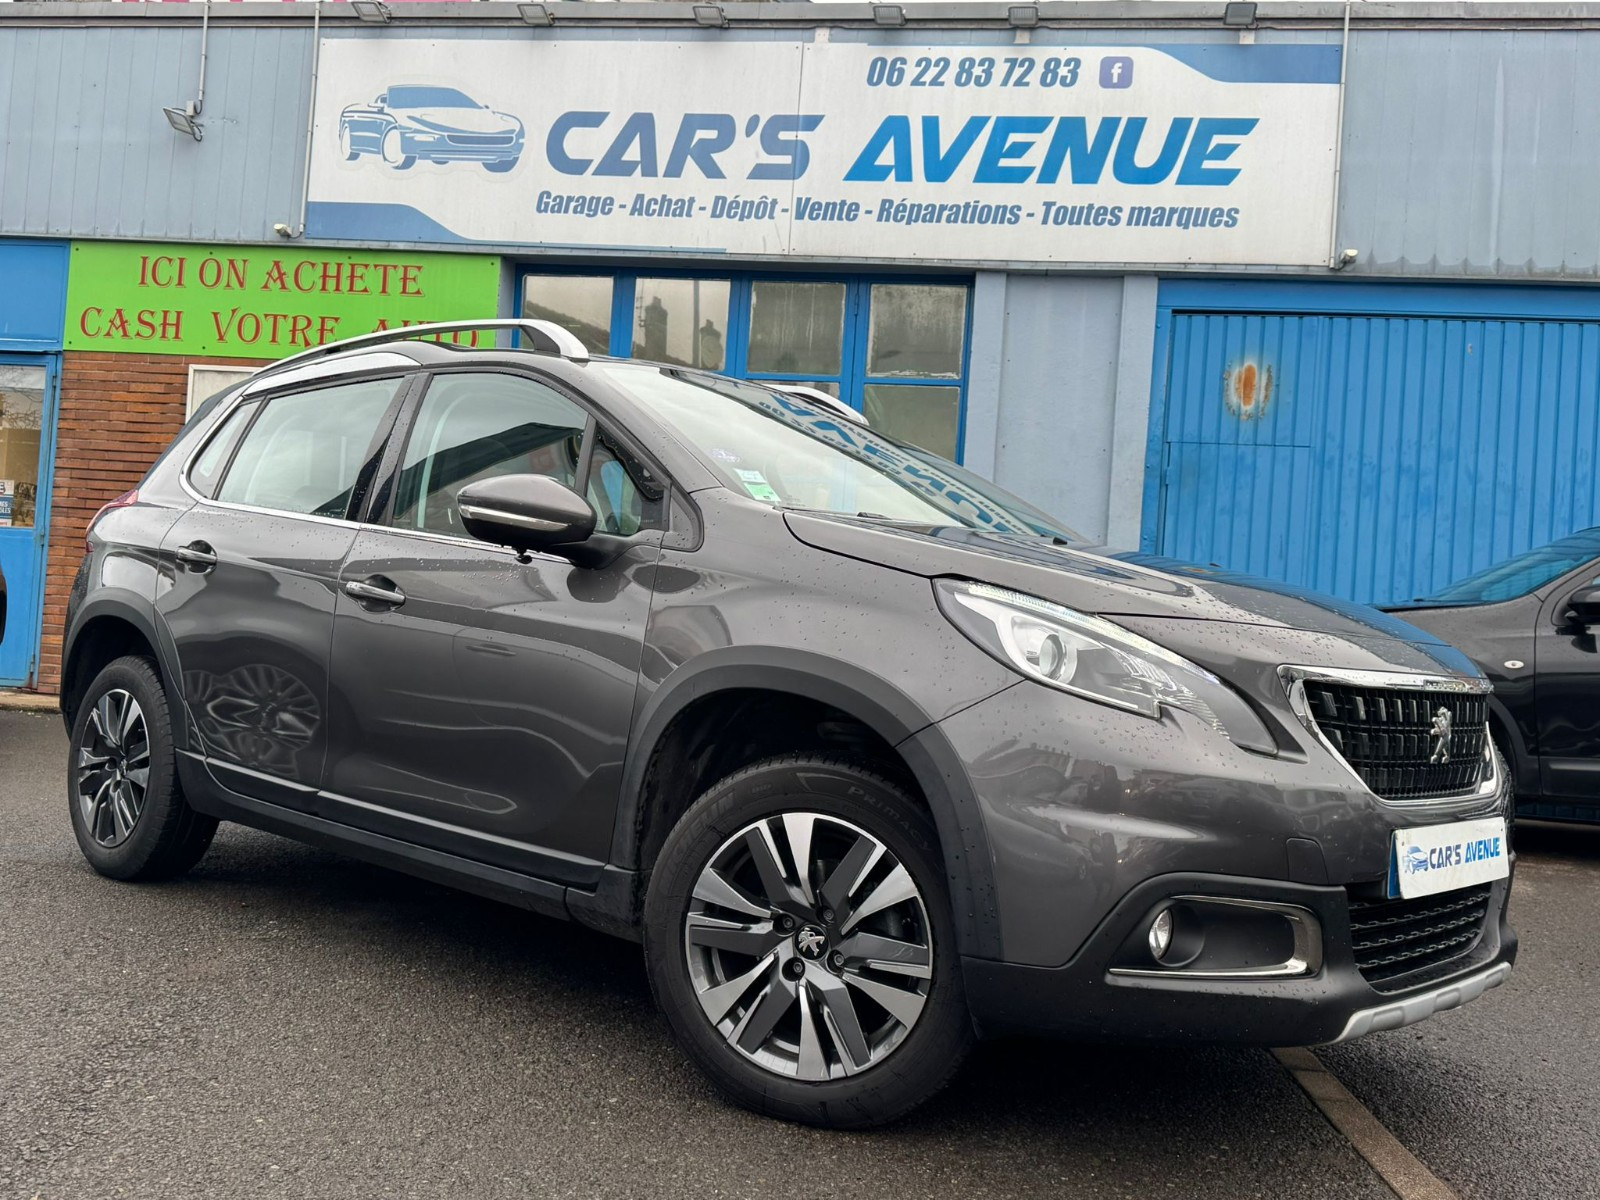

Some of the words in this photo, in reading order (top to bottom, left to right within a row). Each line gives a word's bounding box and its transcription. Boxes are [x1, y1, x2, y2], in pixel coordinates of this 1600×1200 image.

[866, 56, 907, 87] 06
[910, 57, 949, 88] 22
[954, 57, 997, 88] 83
[1000, 57, 1037, 88] 72
[1039, 57, 1081, 88] 83
[546, 110, 825, 180] CAR'S
[842, 114, 1260, 186] AVENUE
[535, 190, 614, 217] Garage
[629, 193, 695, 218] Achat
[710, 195, 779, 222] Dépôt
[794, 196, 859, 223] Vente
[876, 198, 1022, 226] Réparations
[1041, 200, 1123, 227] Toutes
[1126, 205, 1239, 230] marques
[138, 255, 187, 289] ICI
[198, 257, 251, 290] ON
[260, 259, 425, 297] ACHETE
[79, 305, 184, 341] CASH
[211, 306, 341, 348] VOTRE
[1429, 843, 1462, 870] CAR'S
[1464, 837, 1501, 864] AVENUE
